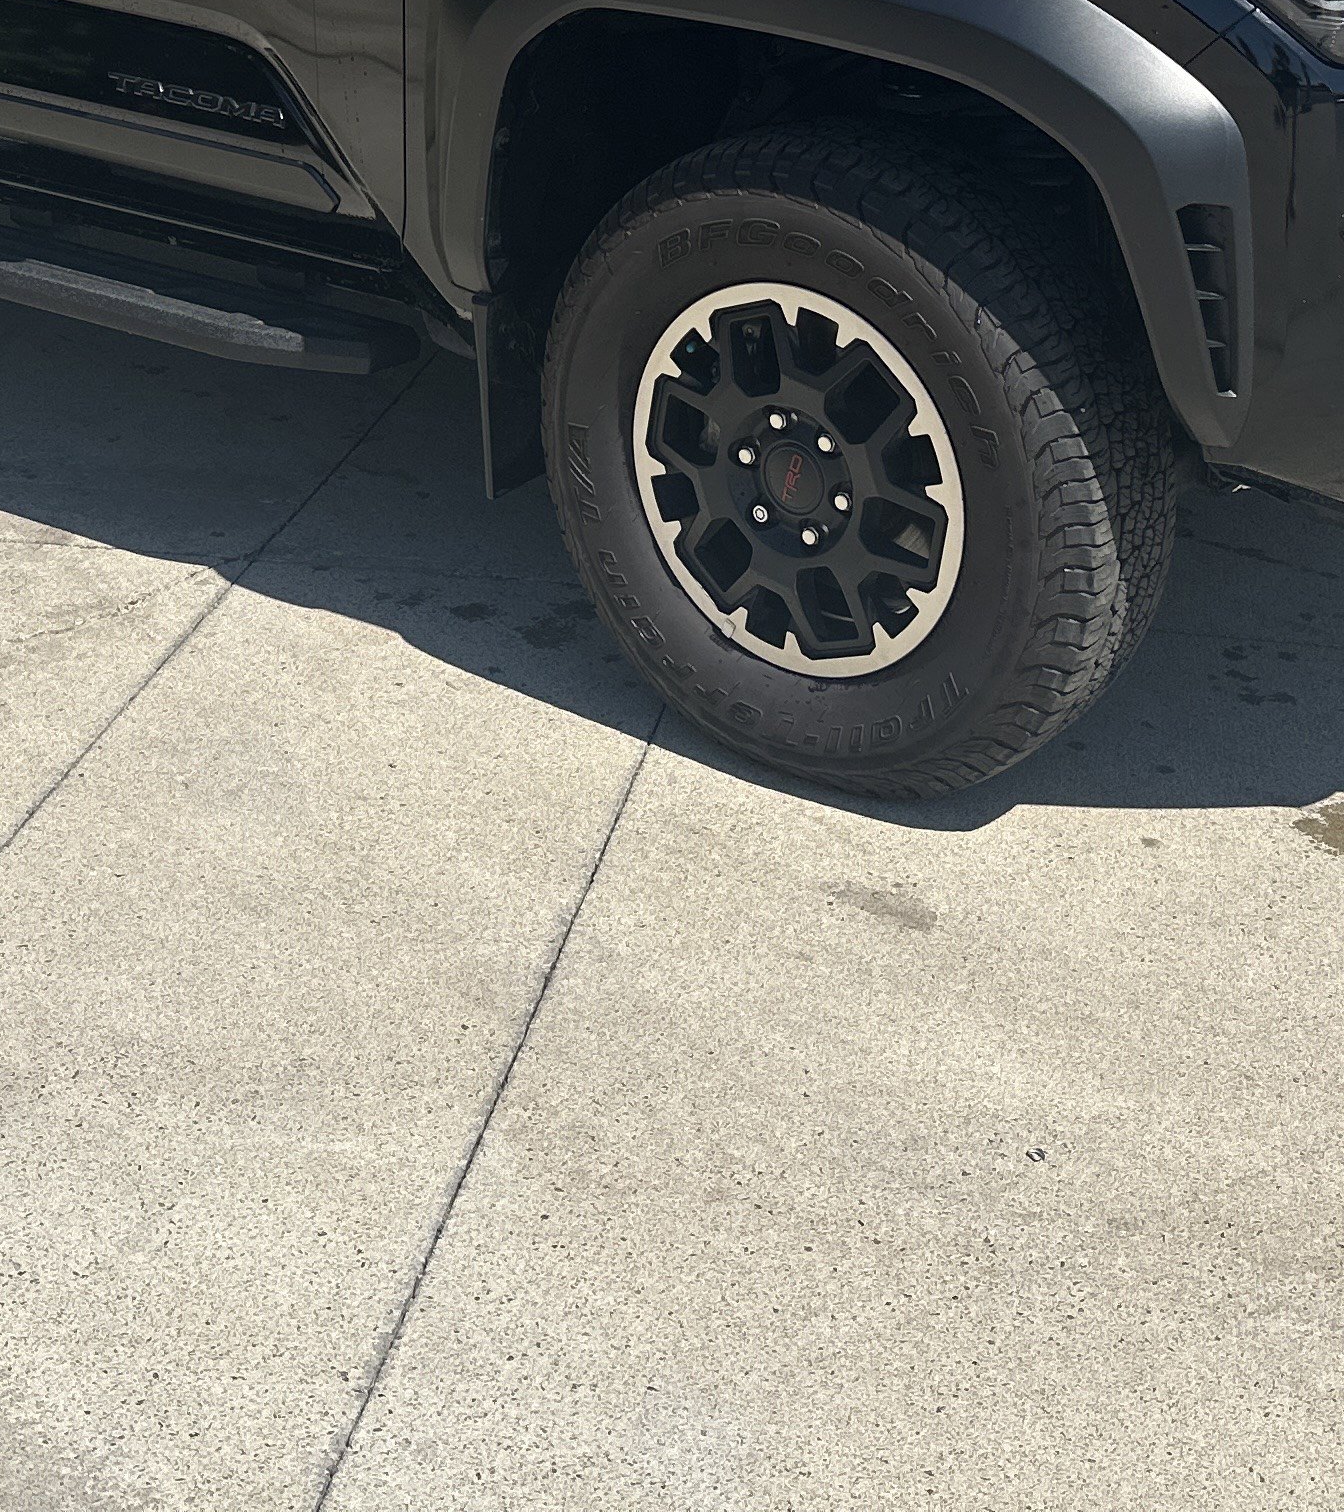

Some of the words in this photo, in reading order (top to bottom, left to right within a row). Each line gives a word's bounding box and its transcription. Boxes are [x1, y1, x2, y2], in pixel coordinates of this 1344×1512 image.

[107, 71, 286, 130] TACOMA
[656, 217, 1000, 469] BFGoodrich
[780, 454, 804, 504] TRD
